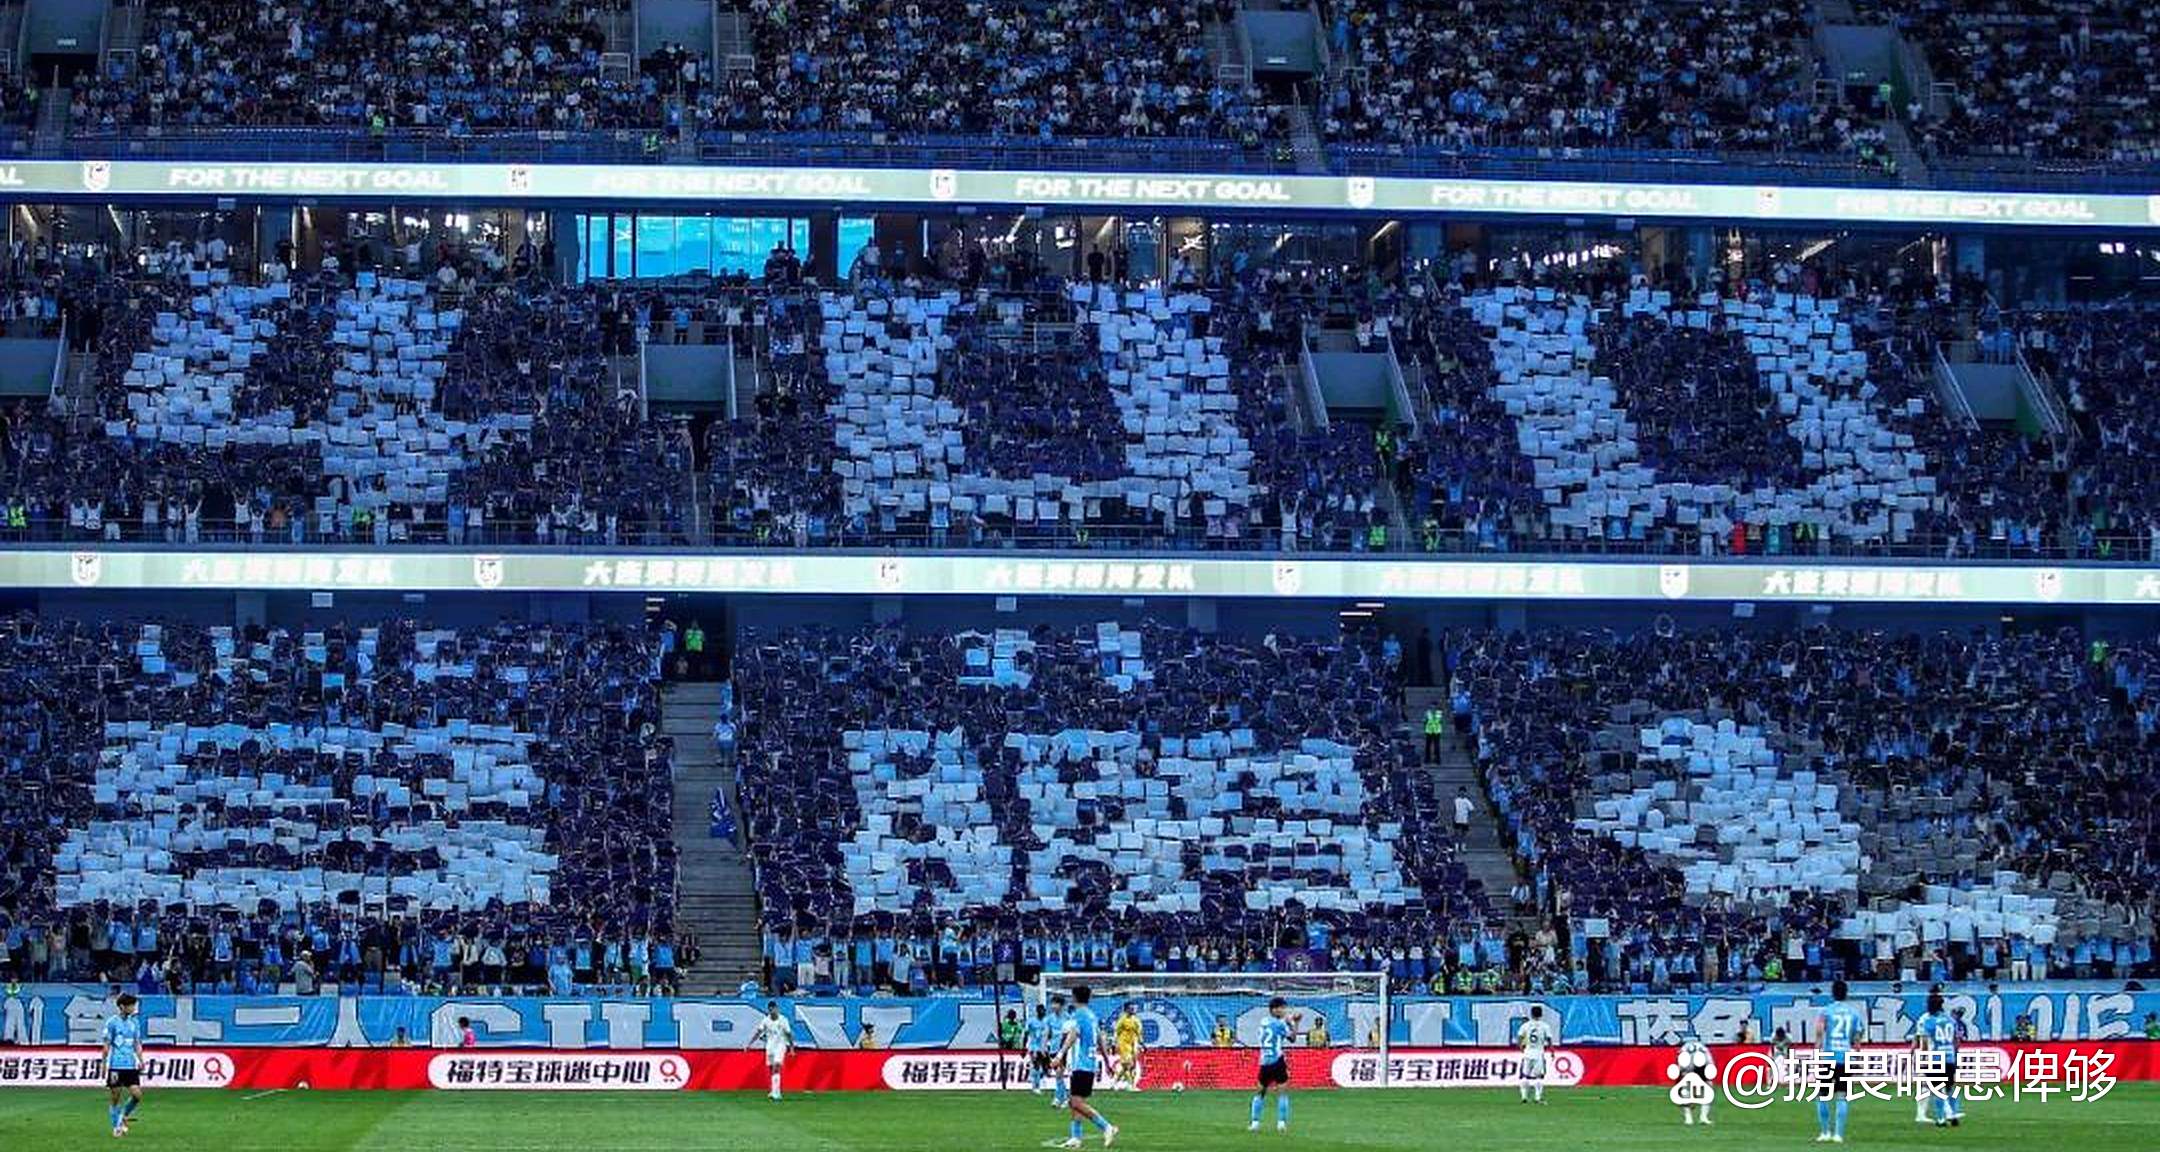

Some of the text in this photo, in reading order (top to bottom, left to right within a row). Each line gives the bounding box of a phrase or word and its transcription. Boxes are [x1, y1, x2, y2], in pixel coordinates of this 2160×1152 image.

[169, 168, 449, 189] FOR THE NEXT GOAL
[591, 173, 870, 194] FOR THE NEXT GOAL
[1015, 178, 1291, 201] FOR THE NEXT GOAL
[1431, 185, 1697, 209] FOR THE NEXT GOAL
[1836, 196, 2095, 219] FOR THE NEXT GOAL
[1528, 1028, 1539, 1044] 6
[1831, 1013, 1852, 1039] 21
[0, 1056, 195, 1081] 福特宝球中心
[447, 1059, 651, 1085] 福特宝球迷中心
